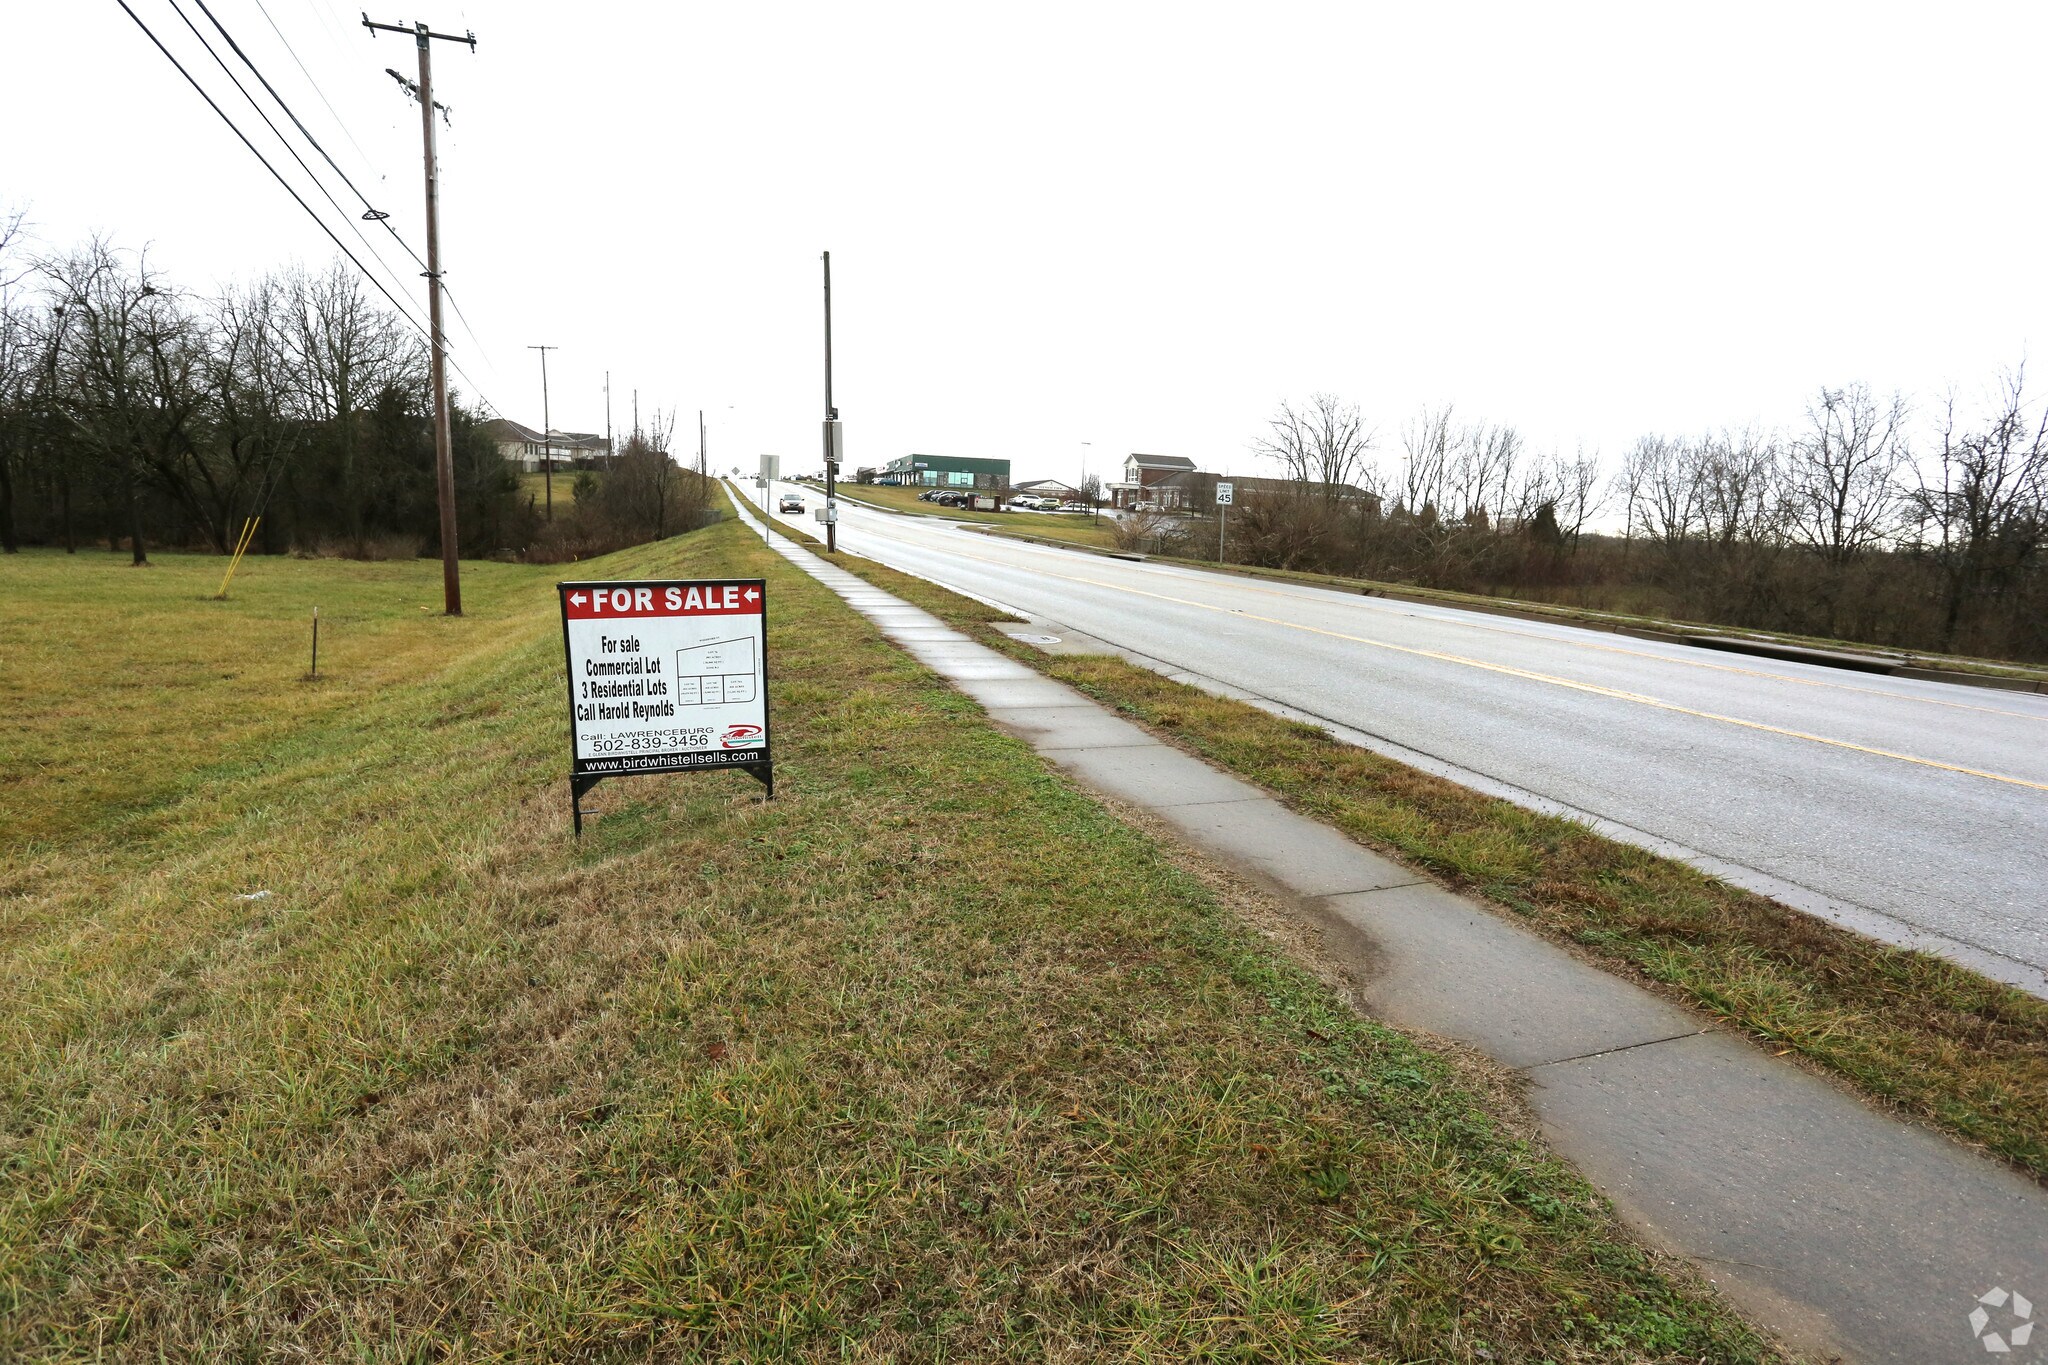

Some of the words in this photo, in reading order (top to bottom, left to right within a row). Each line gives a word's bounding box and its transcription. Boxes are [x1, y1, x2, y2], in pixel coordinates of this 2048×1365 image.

[1218, 494, 1231, 502] 45
[592, 587, 654, 612] FOR
[664, 586, 740, 611] SALE
[601, 635, 617, 654] For
[620, 634, 640, 653] sale
[586, 656, 643, 677] Commercial
[645, 656, 661, 674] Lot
[582, 681, 588, 699] 3
[591, 679, 644, 699] Residential
[647, 678, 667, 696] Lots
[577, 703, 596, 722] Call
[599, 701, 630, 720] Harold
[632, 700, 674, 722] Reynolds
[580, 733, 606, 741] Call:
[610, 726, 714, 740] LAWRENCEBURG
[593, 734, 708, 752] 502-839-3456
[585, 751, 758, 771] www.birdwhistellsells.com
